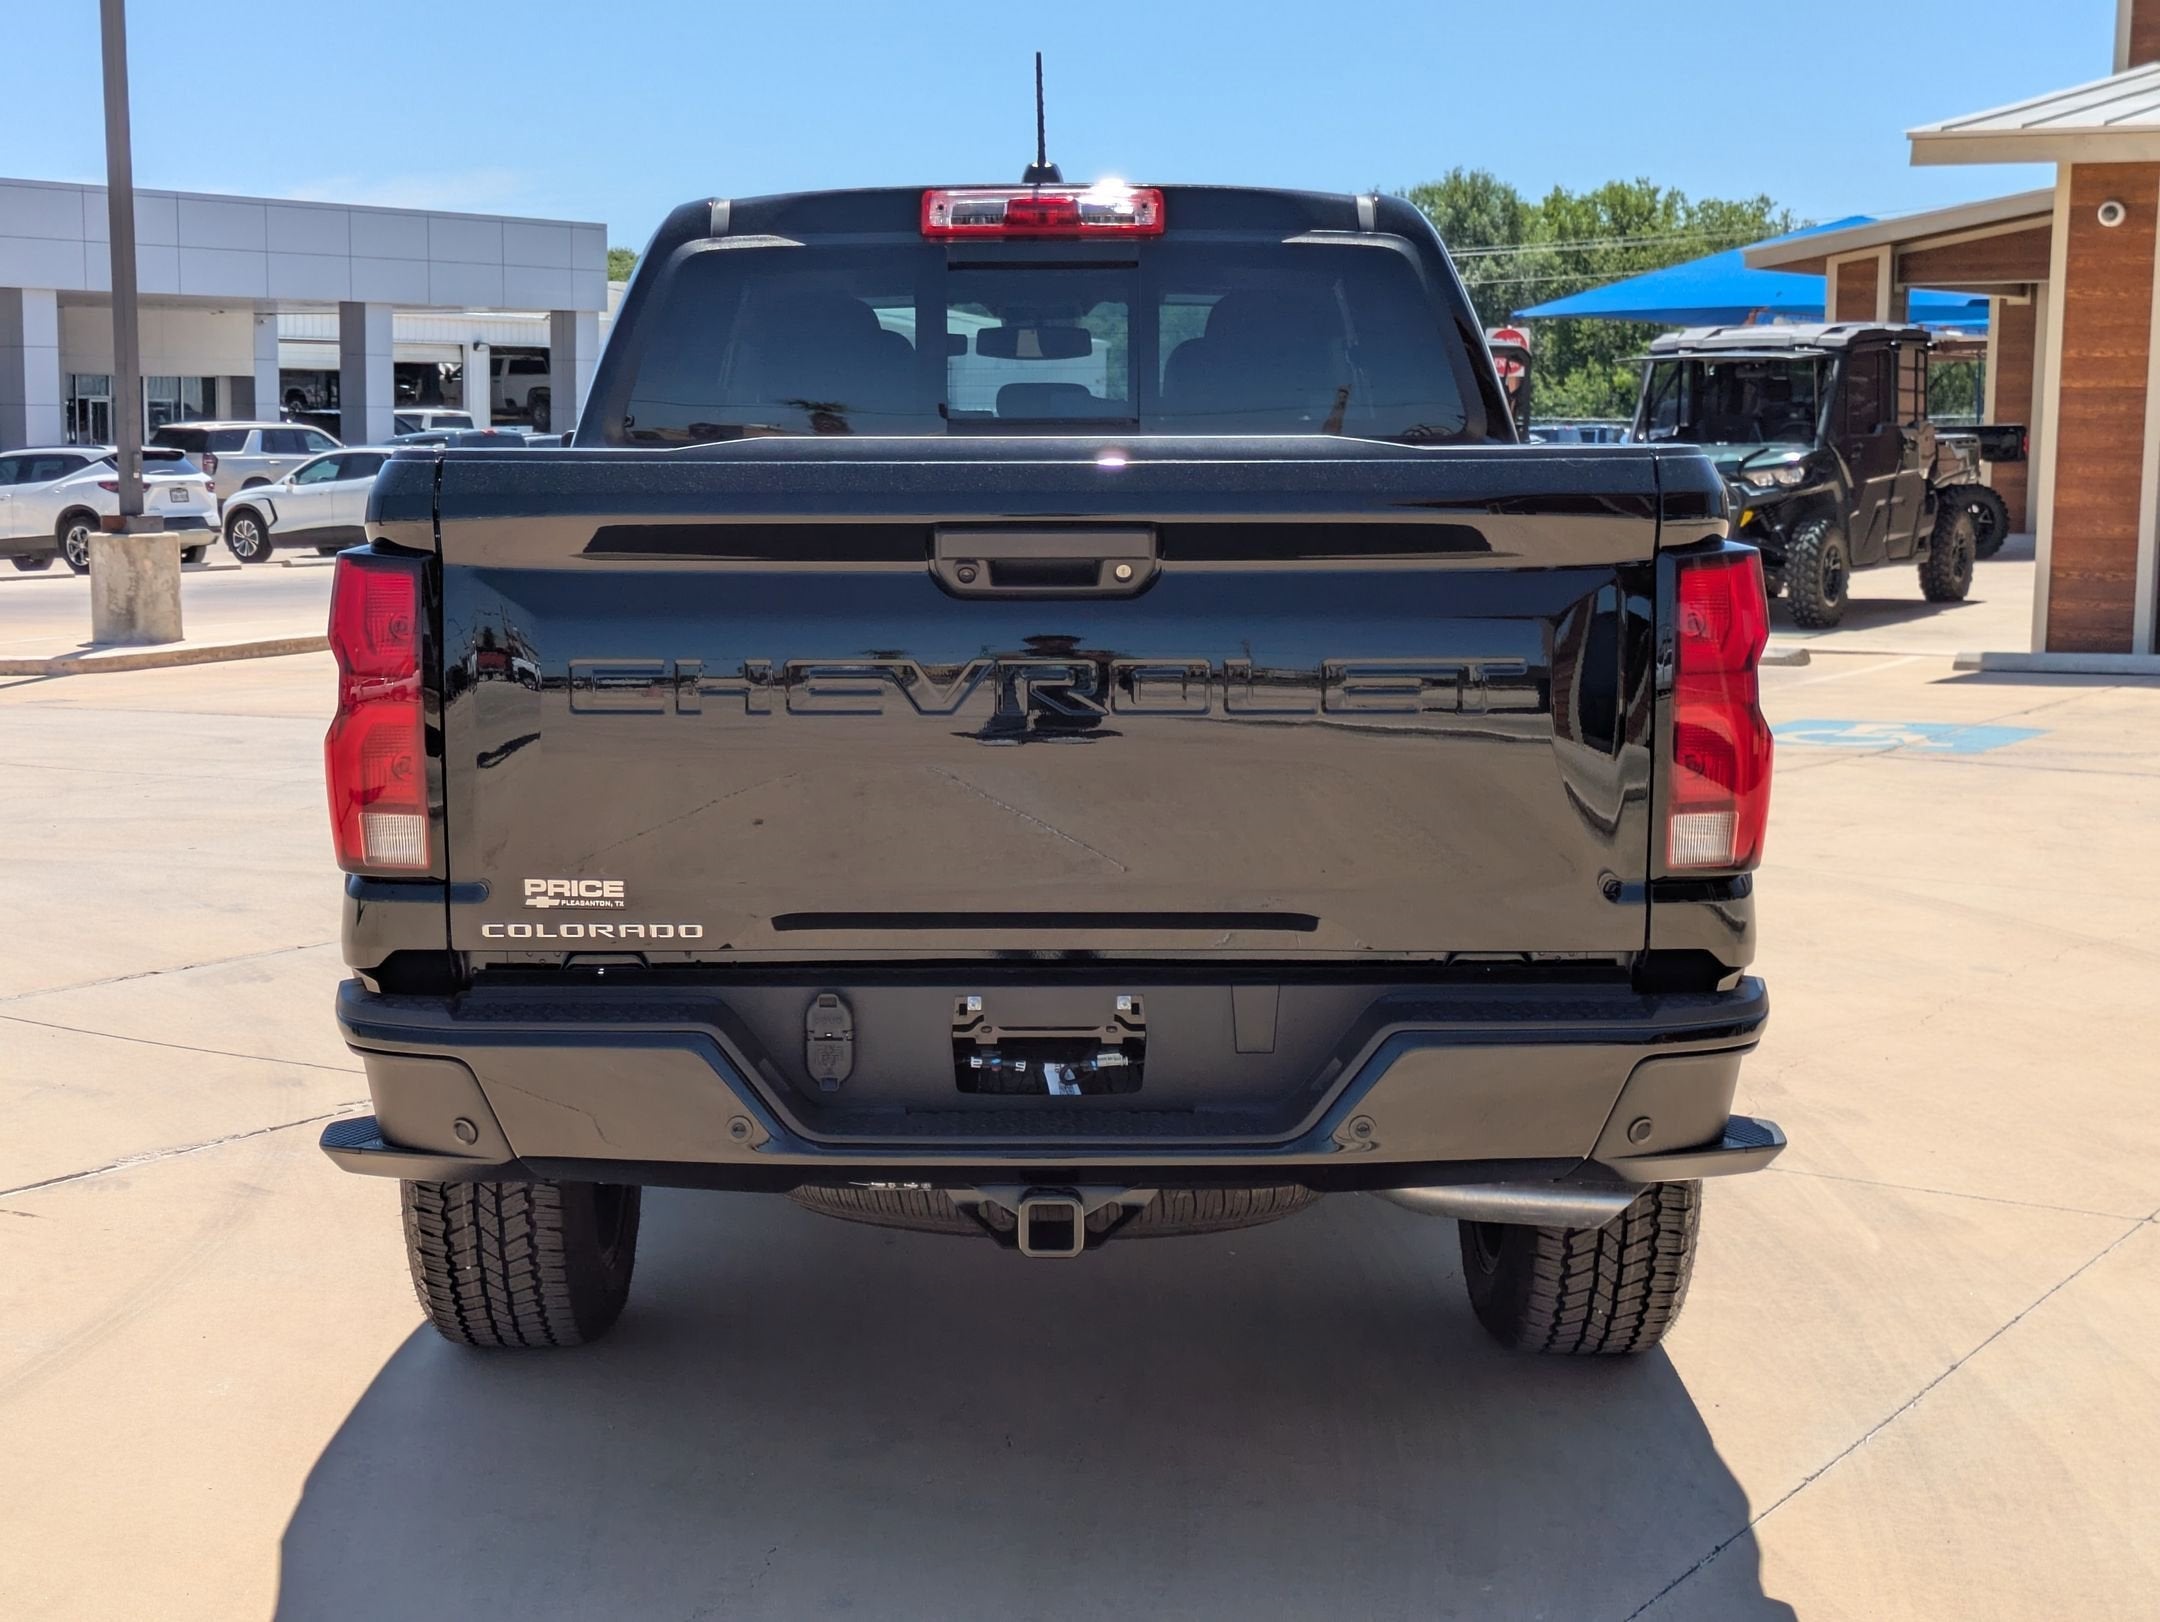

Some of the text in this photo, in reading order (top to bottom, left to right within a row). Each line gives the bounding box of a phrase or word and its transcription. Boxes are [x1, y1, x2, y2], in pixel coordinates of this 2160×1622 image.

[568, 657, 1527, 716] CHEVROLET
[524, 878, 625, 898] PRICE
[561, 899, 613, 908] PLEASANTON,
[481, 923, 703, 938] COLORADO
